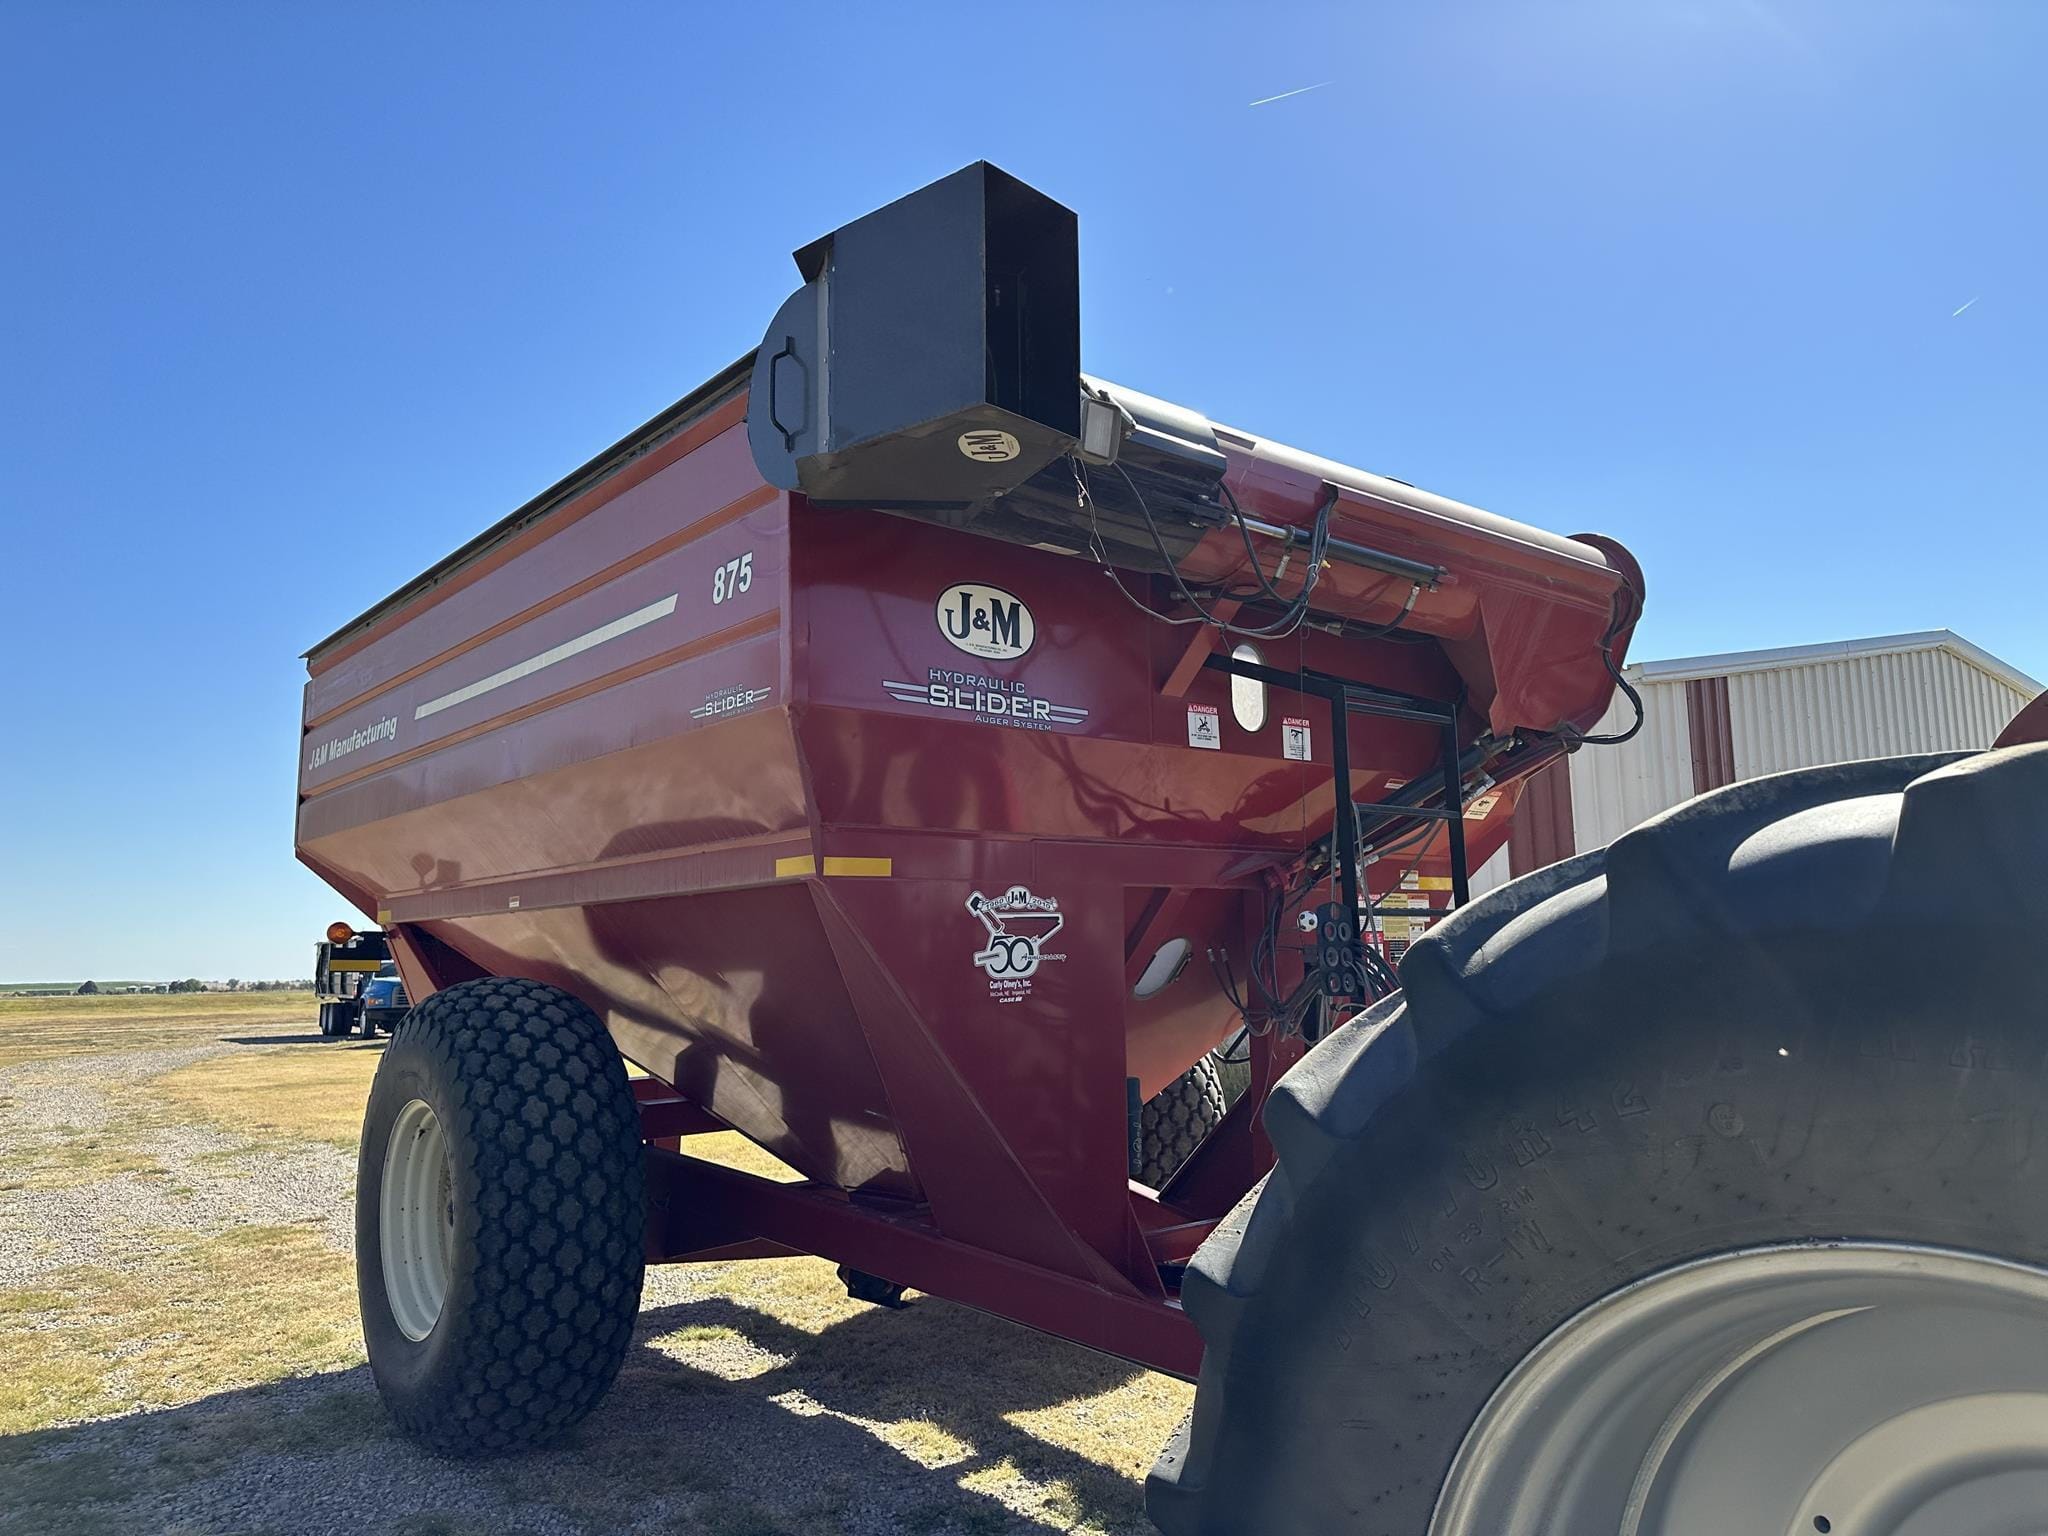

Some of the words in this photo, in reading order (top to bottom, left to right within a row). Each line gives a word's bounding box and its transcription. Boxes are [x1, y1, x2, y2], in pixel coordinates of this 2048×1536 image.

[964, 433, 1009, 460] J&M
[713, 552, 753, 605] 875
[945, 591, 1023, 649] J&M
[929, 668, 1025, 694] HYDRAULIC
[705, 689, 754, 716] SLIDER
[928, 684, 1053, 721] SLIDER
[1193, 705, 1218, 715] DANGER
[1287, 718, 1310, 728] DANGER
[308, 743, 329, 771] J&M
[328, 716, 398, 762] Manufacturing
[1008, 891, 1027, 904] J&M
[989, 935, 1034, 973] 50
